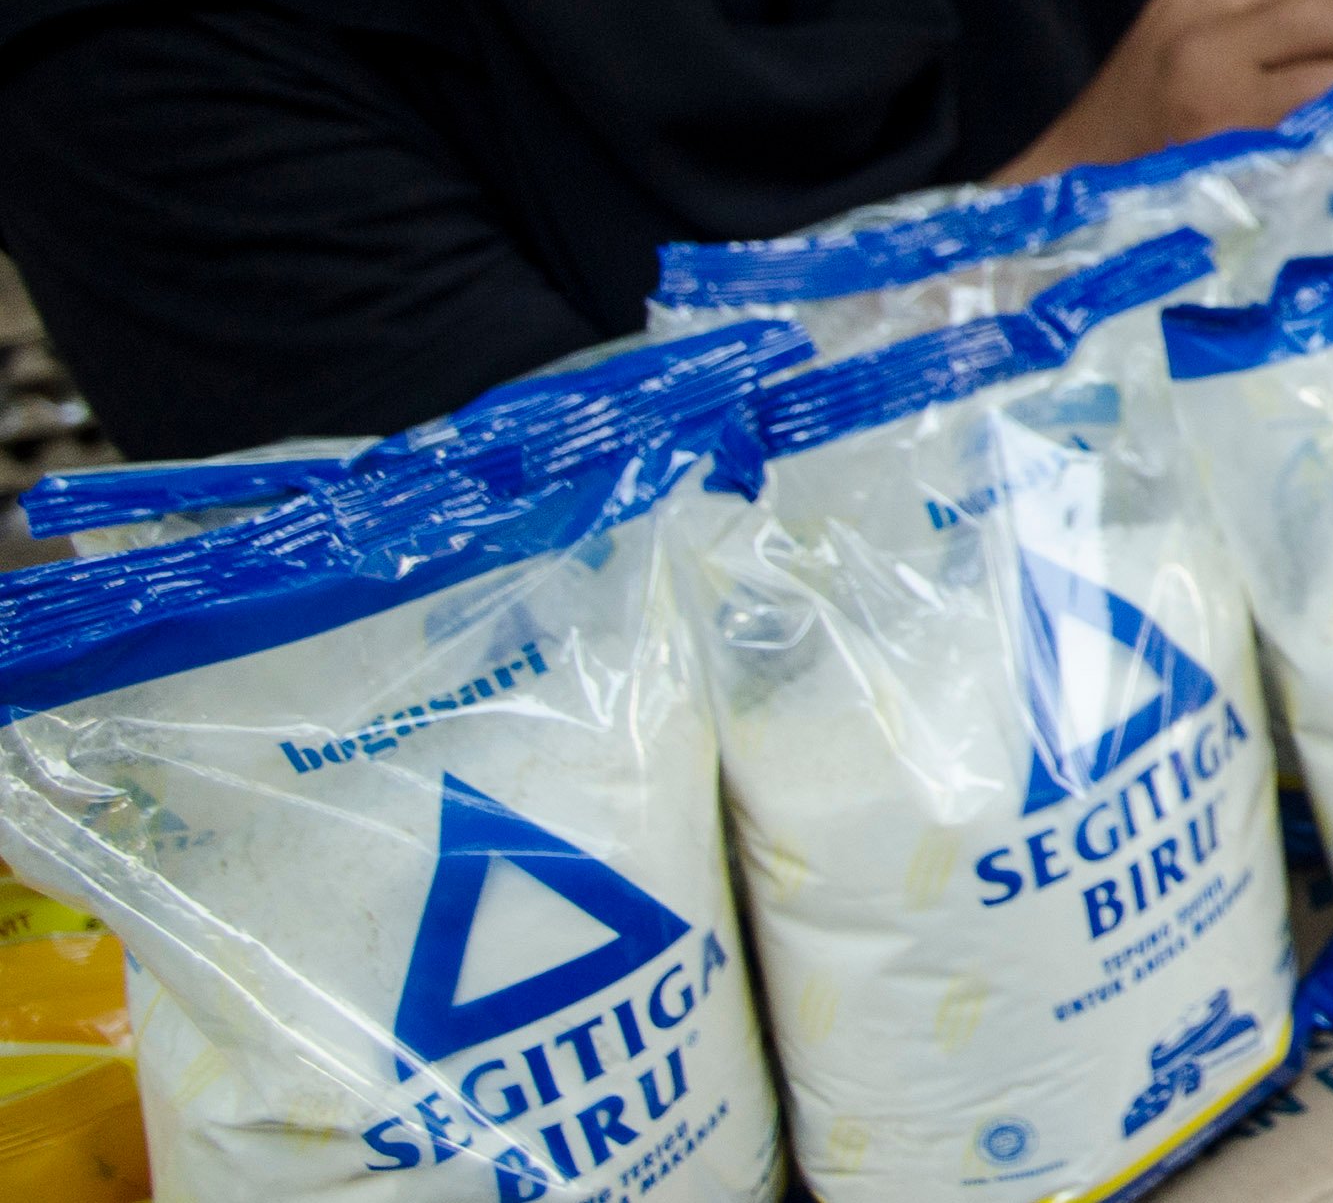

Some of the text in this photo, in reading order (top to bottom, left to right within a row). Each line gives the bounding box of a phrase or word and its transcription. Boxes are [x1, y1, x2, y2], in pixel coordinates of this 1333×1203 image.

[279, 642, 549, 775] bogasari
[975, 699, 1248, 907] SEGITIGA
[1082, 799, 1218, 940] BIRU
[361, 928, 729, 1171] SEGITIGA
[494, 1045, 690, 1203] BIRU
